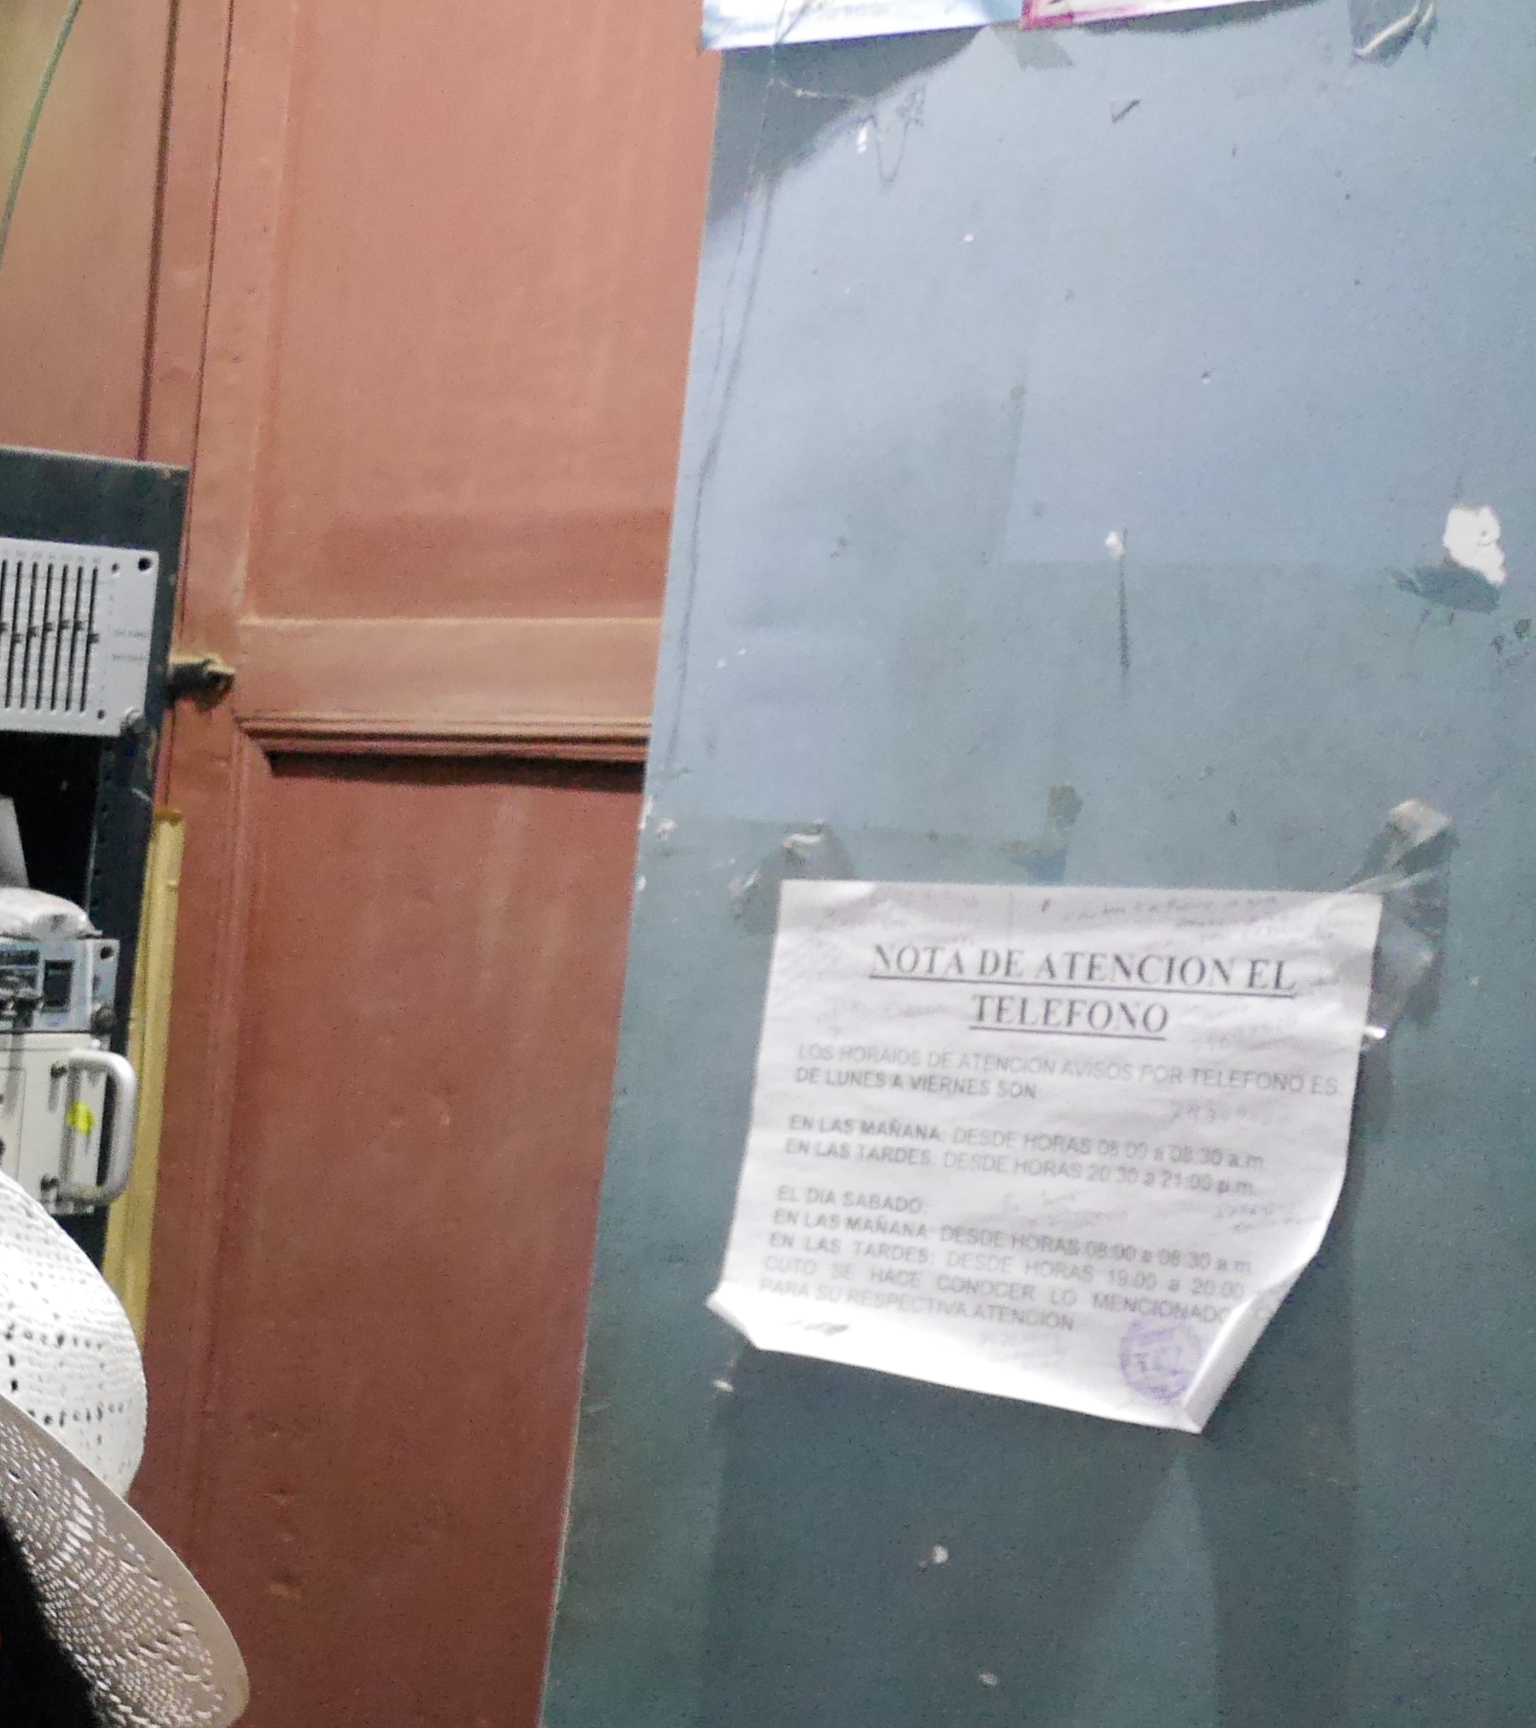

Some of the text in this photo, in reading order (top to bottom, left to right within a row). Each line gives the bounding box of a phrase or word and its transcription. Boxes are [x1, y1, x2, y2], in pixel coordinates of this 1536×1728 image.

[871, 943, 1297, 991] NOTA DE ATENCION EL
[971, 993, 1169, 1034] TELEFONO
[795, 1066, 1038, 1100] DE LUNES A VIERNES SON
[798, 1043, 834, 1060] LOS
[929, 1050, 954, 1069] DE
[958, 1052, 1057, 1075] ATENCION
[1060, 1060, 1134, 1082] AVISOS
[1139, 1064, 1184, 1085] POR
[1191, 1067, 1305, 1093] TELEFONO
[1311, 1075, 1339, 1096] ES
[788, 1113, 815, 1132] EN
[819, 1116, 855, 1135] LAS
[952, 1126, 1016, 1149] DESDE
[1023, 1132, 1091, 1156] HORAS
[785, 1137, 810, 1156] EN
[815, 1140, 851, 1160] LAS
[943, 1150, 1009, 1174] DESDE
[1014, 1156, 1083, 1180] HORAS
[777, 1184, 800, 1202] EL
[806, 1186, 837, 1206] DIA
[774, 1208, 799, 1226] EN
[804, 1211, 840, 1231] LAS
[940, 1224, 1005, 1250] DESDE
[1011, 1234, 1079, 1256] HORAS
[769, 1231, 795, 1250] EN
[804, 1235, 842, 1255] LAS
[946, 1249, 1015, 1275] DESDE
[1026, 1259, 1095, 1284] HORAS
[756, 1277, 1074, 1332] PARA SU RESPECTIVA ATENCION
[831, 1260, 856, 1281] SE
[870, 1267, 923, 1290] HACE
[936, 1273, 1036, 1301] CONOCER
[1050, 1287, 1078, 1307] LO
